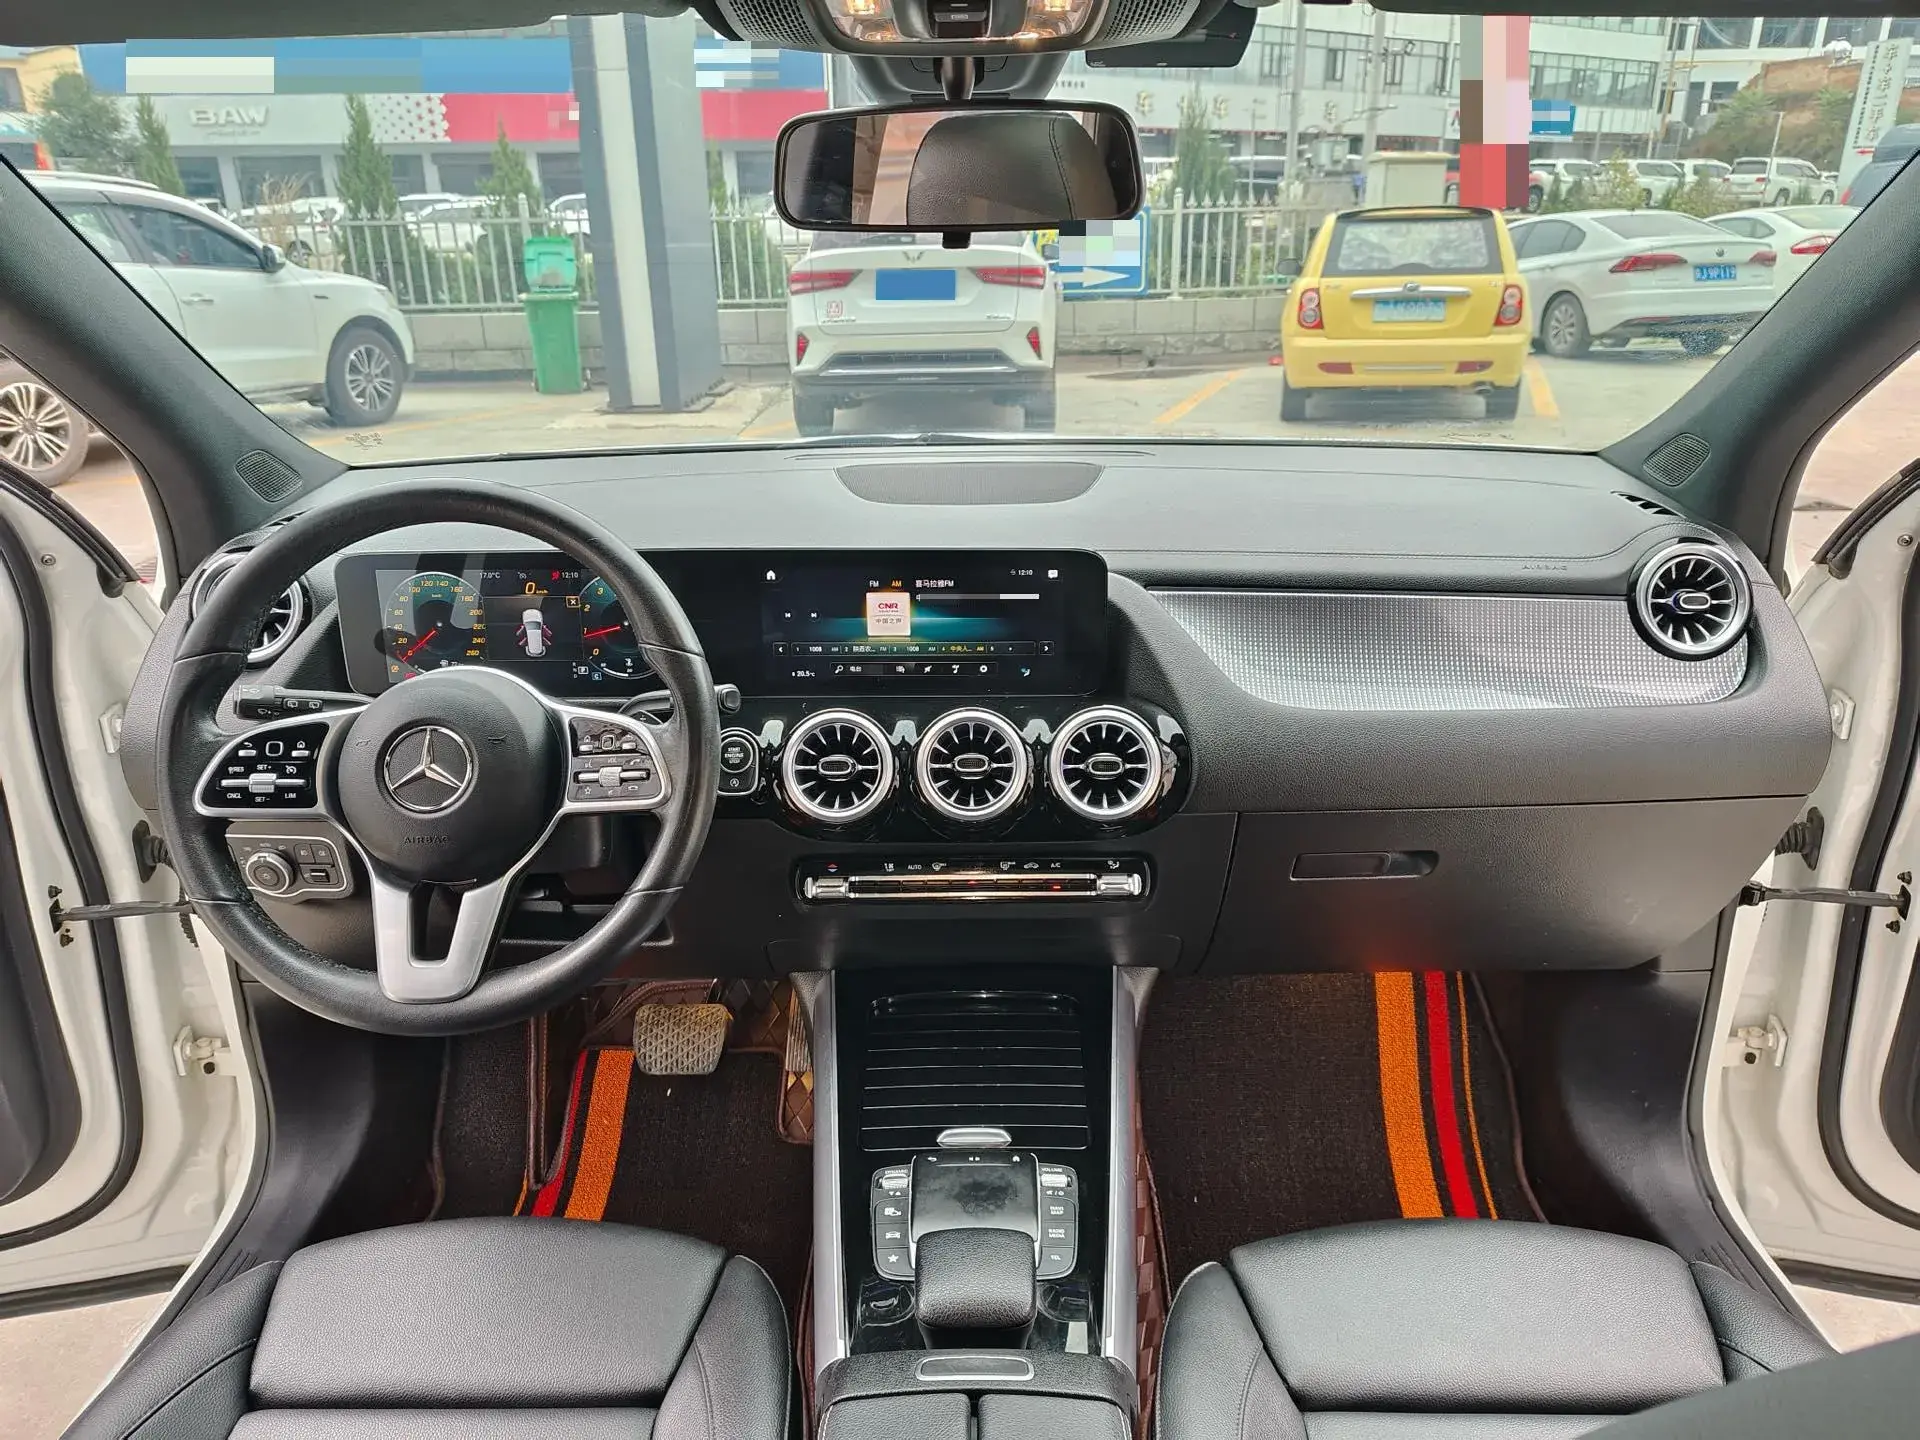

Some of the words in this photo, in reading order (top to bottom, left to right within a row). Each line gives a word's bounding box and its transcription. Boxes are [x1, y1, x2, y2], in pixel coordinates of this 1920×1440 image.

[189, 104, 271, 126] BAW
[869, 580, 880, 588] FM
[891, 580, 902, 588] AM
[525, 582, 536, 595] 0
[597, 587, 604, 595] 3
[583, 604, 591, 612] 2
[877, 602, 899, 610] CNR
[592, 648, 599, 656] 0
